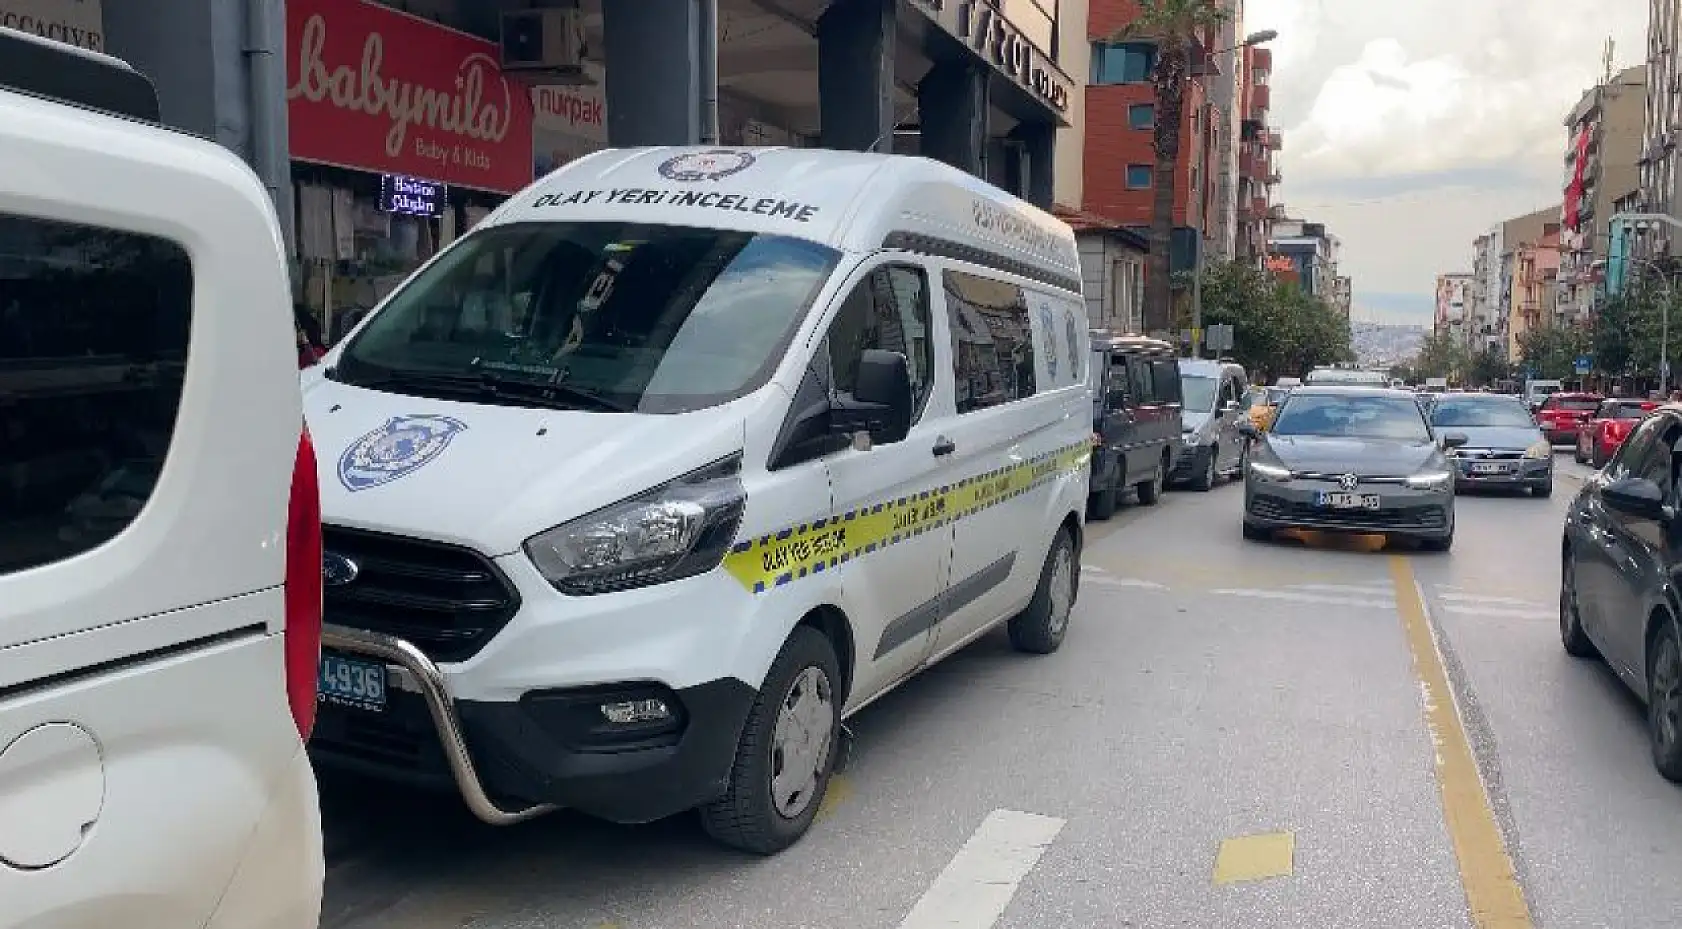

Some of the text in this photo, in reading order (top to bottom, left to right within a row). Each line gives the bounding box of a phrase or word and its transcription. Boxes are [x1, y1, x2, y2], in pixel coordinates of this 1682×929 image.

[287, 14, 510, 157] babymila
[540, 89, 602, 127] nurpak
[416, 137, 449, 167] Baby
[464, 148, 491, 170] Kids
[532, 190, 601, 208] OLAY
[324, 659, 381, 698] 4936
